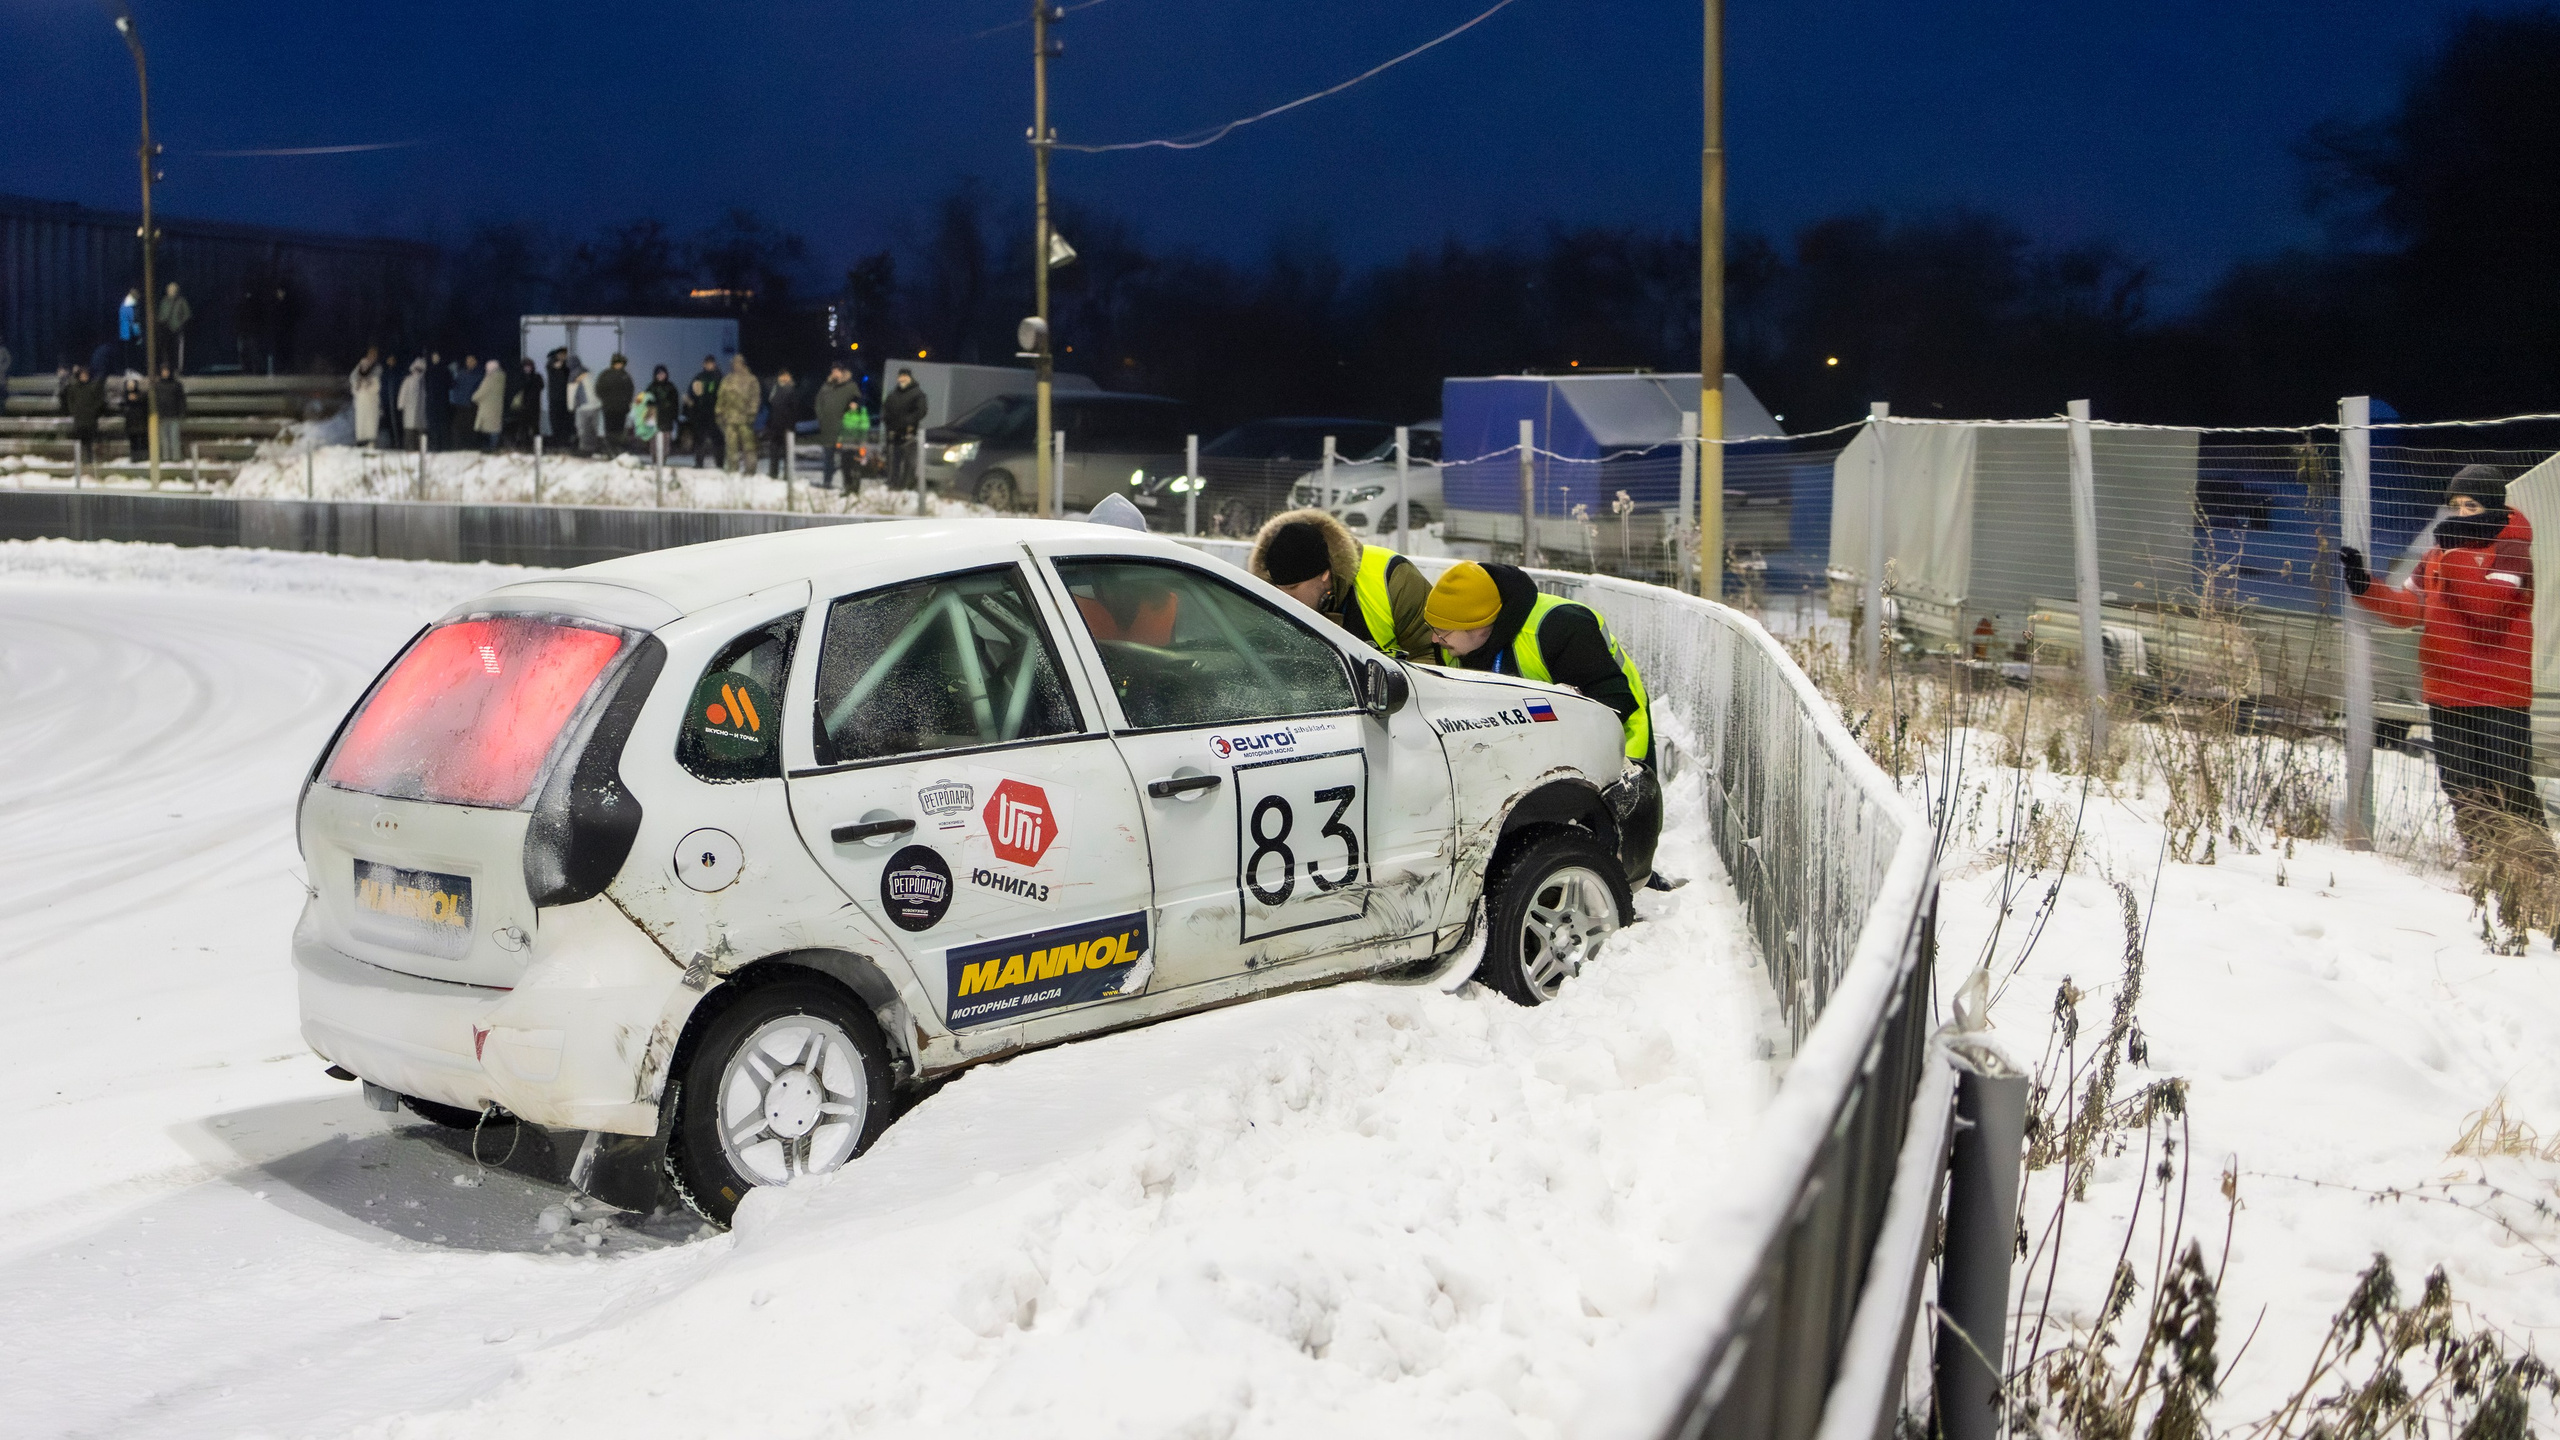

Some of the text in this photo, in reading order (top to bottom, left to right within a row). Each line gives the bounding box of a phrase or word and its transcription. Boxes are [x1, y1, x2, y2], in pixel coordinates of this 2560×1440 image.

[1498, 709, 1532, 726] К.В.
[705, 727, 729, 737] ВКУСНО
[740, 733, 759, 743] ТОЧКА
[923, 790, 970, 809] РЕТРОПАРК
[998, 793, 1043, 853] Uni
[1246, 785, 1359, 906] 83
[894, 877, 942, 896] РЕТРОПАРК
[971, 868, 1049, 902] ЮНИГАЗ
[951, 987, 1063, 1020] МОТОРНЫЕ МАСЛА
